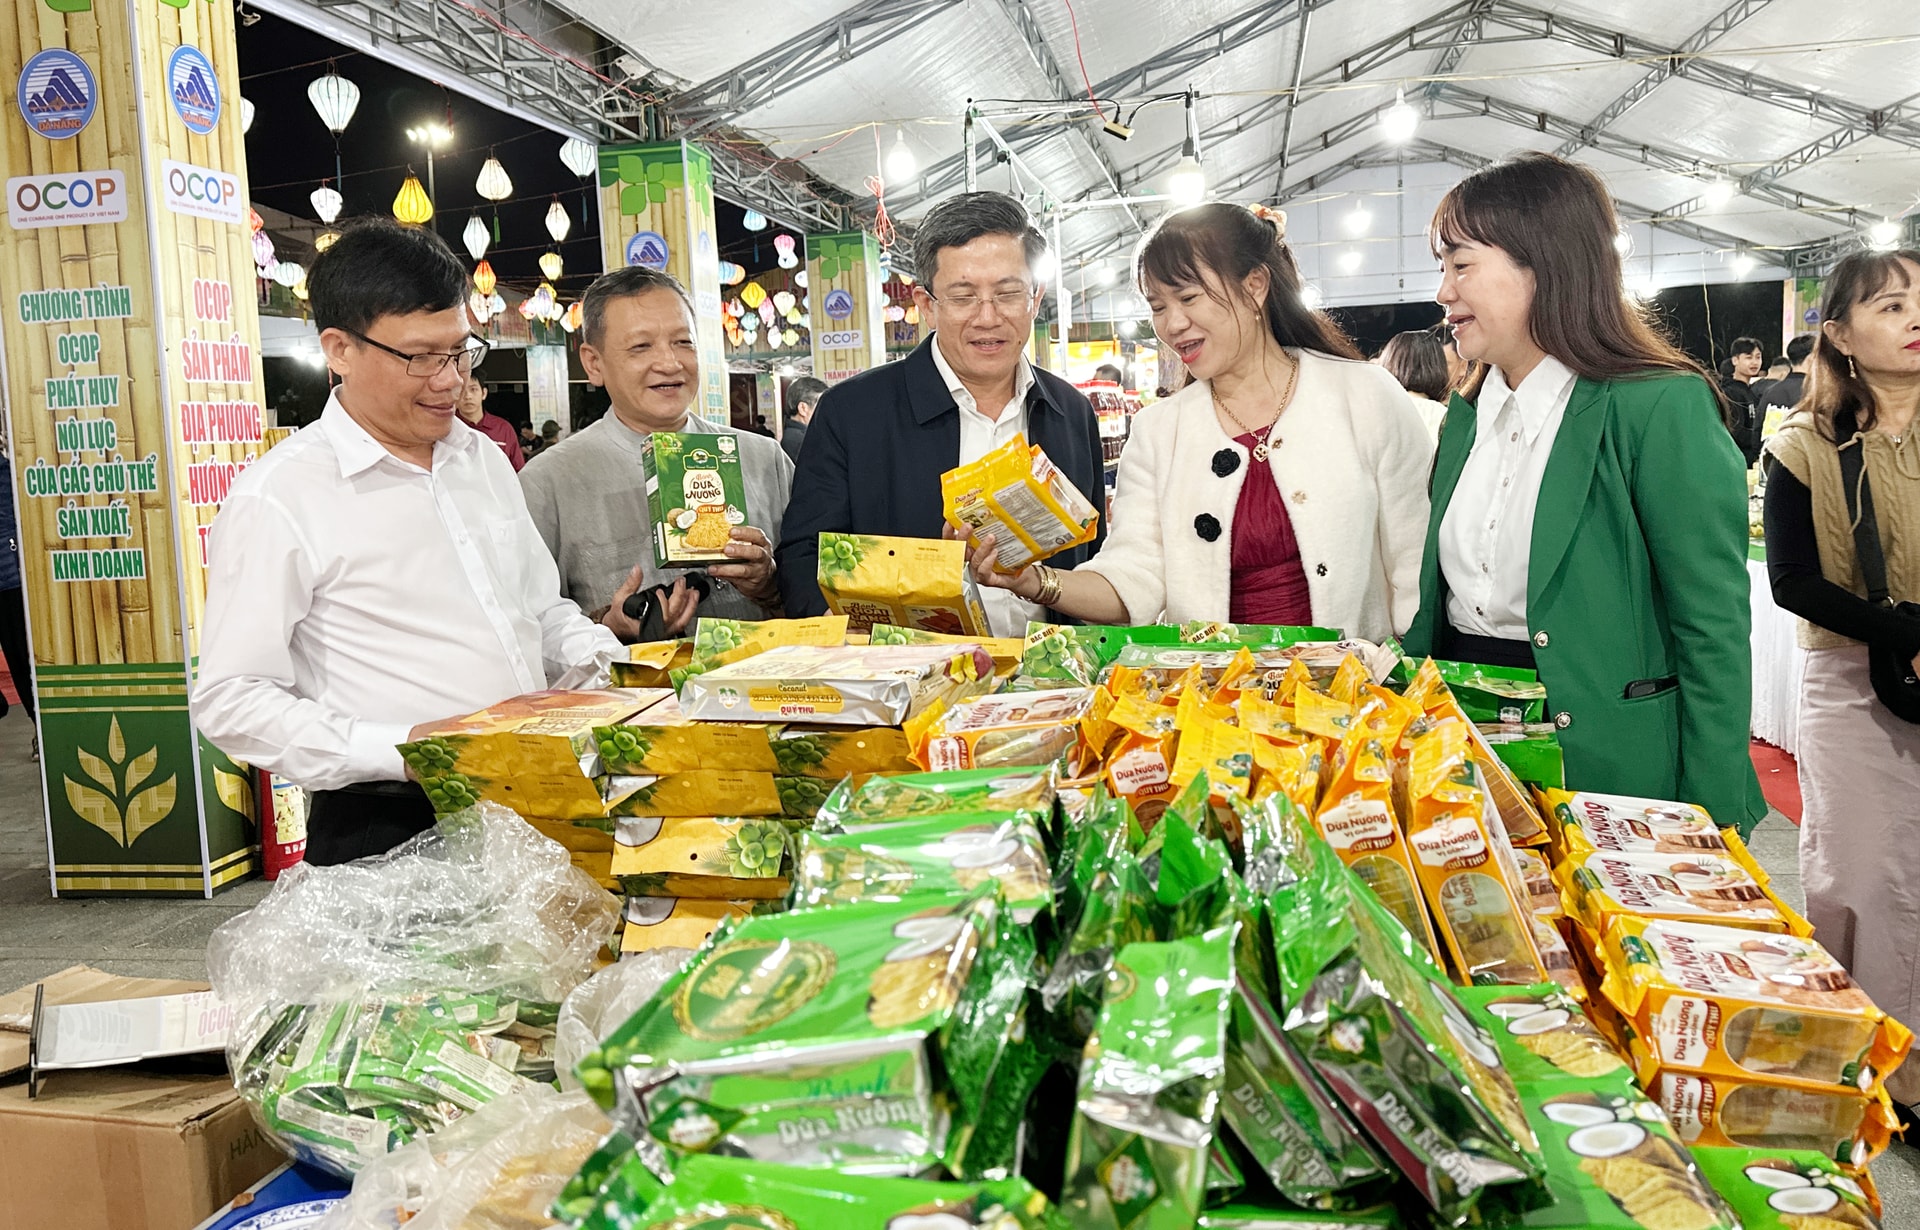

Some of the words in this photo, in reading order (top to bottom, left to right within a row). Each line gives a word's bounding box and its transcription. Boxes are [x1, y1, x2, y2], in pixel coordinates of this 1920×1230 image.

[17, 178, 116, 211] OCOP
[169, 168, 235, 205] OCOP
[20, 290, 82, 322] CHƯƠNG
[84, 284, 131, 318] TRÌNH
[193, 280, 230, 321] OCOP
[58, 334, 99, 363] OCOP
[822, 333, 859, 344] OCOP
[182, 332, 210, 381] SẢN
[212, 331, 251, 382] PHẨM
[46, 374, 85, 408] PHÁT
[89, 376, 119, 406] HUY
[57, 418, 83, 458] NỘI
[87, 420, 116, 454] LỰC
[181, 403, 206, 452] ĐỊA
[209, 404, 262, 442] PHƯƠNG
[26, 459, 57, 496] CỦA
[59, 457, 90, 493] CÁC
[93, 455, 126, 492] CHỦ
[128, 455, 157, 490] THỂ
[58, 501, 89, 537] SẢN
[91, 501, 132, 537] XUẤT,
[53, 552, 89, 580] KINH
[94, 551, 144, 578] DOANH
[778, 683, 807, 692] Coconut
[781, 705, 797, 715] QUÝ
[797, 706, 814, 714] THU
[1677, 1000, 1694, 1036] Nướng
[1709, 1006, 1719, 1025] THU
[1674, 1038, 1687, 1061] Dừa
